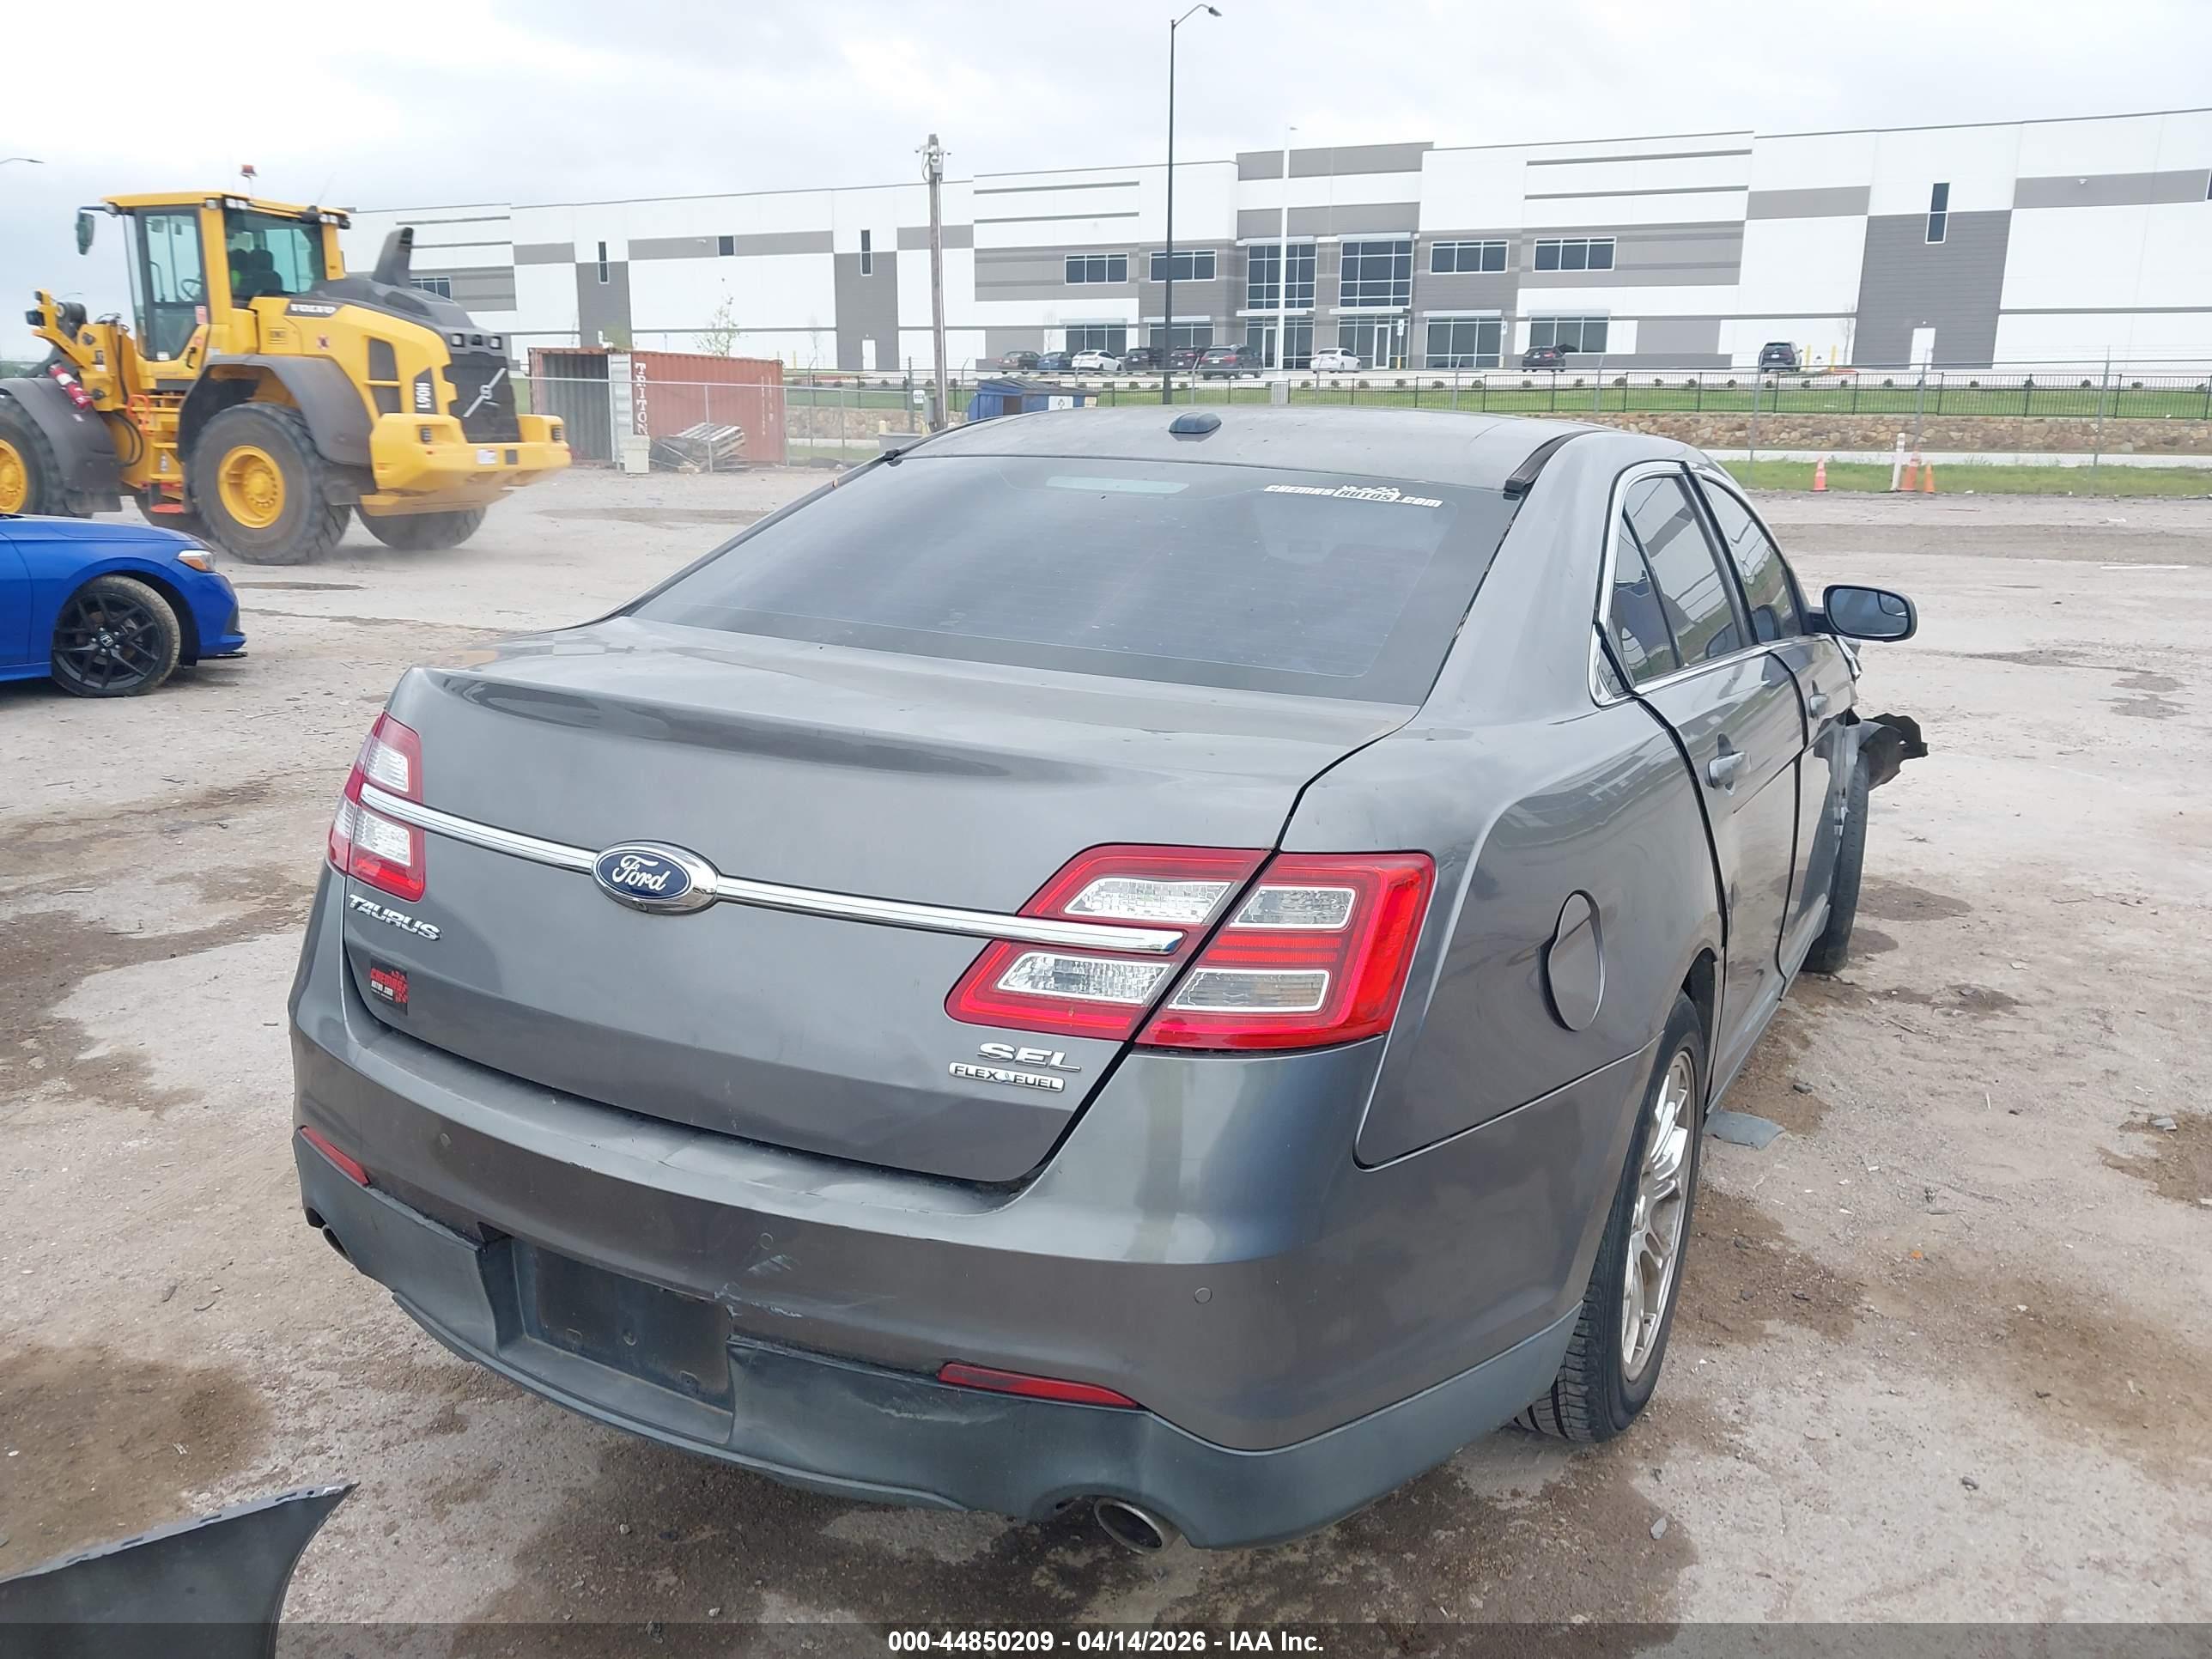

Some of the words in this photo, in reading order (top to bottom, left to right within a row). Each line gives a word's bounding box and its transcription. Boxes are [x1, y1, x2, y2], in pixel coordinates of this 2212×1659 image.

[635, 362, 648, 435] TRITON
[612, 855, 672, 891] Ford
[348, 893, 442, 941] TAURUS
[977, 1042, 1082, 1073] SEL
[954, 1065, 1000, 1081] FLEX
[1012, 1075, 1061, 1091] FUEL
